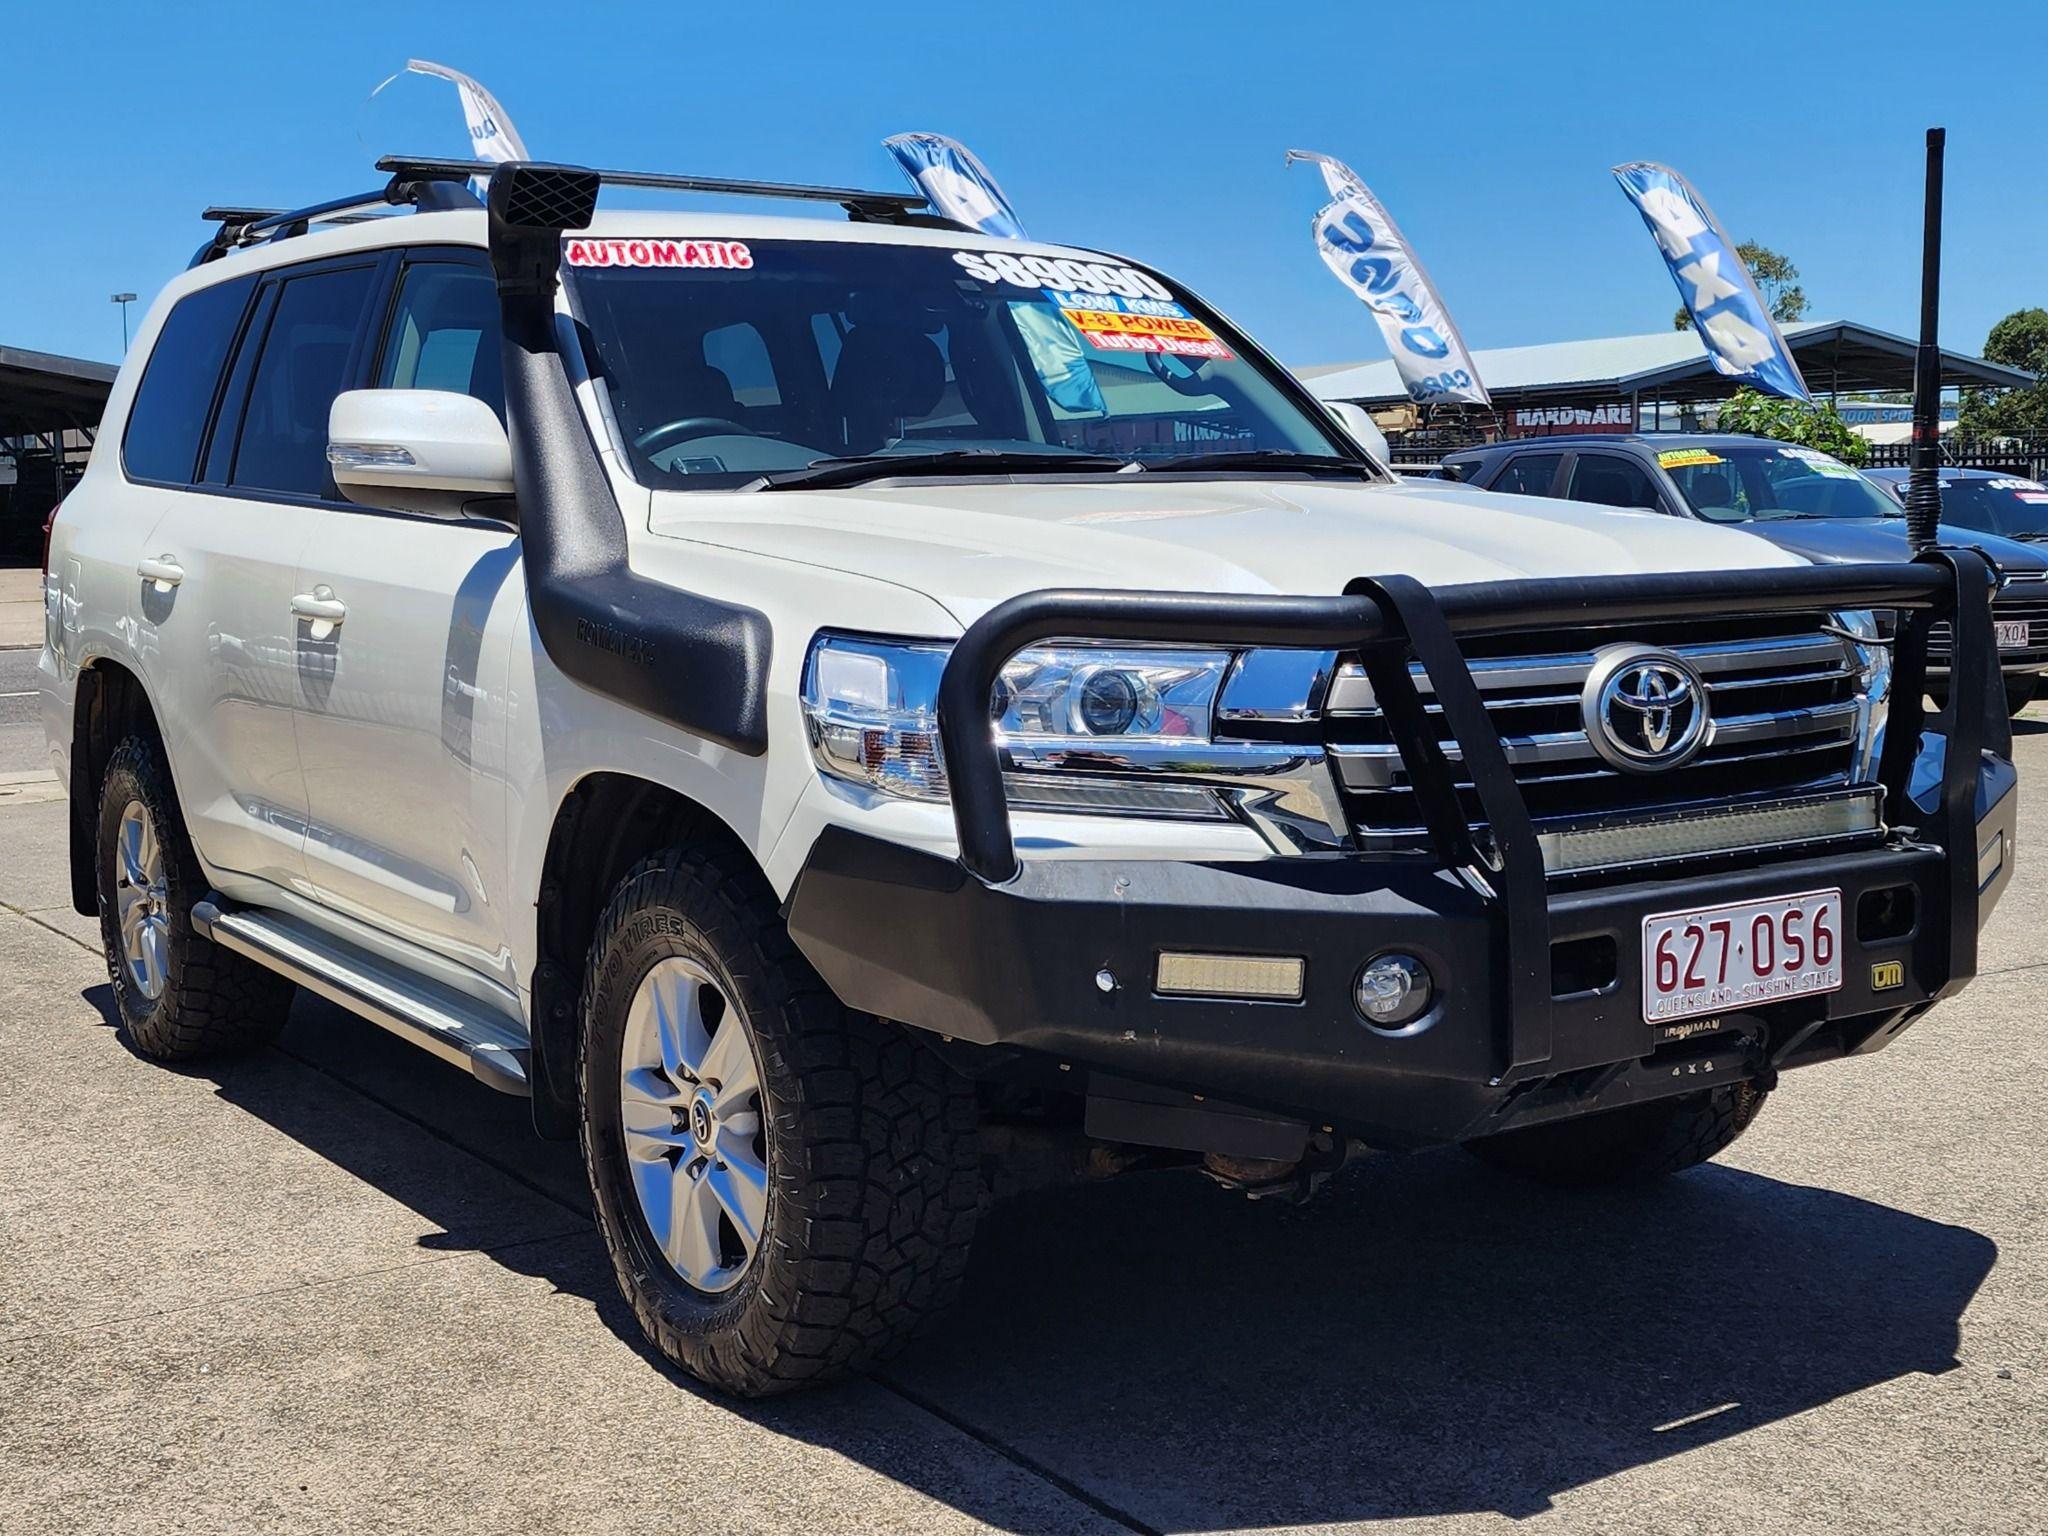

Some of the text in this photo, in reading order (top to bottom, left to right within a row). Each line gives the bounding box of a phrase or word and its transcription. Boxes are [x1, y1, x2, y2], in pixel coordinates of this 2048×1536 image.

[567, 240, 753, 268] AUTOMATIC
[952, 251, 1174, 301] $89990
[1053, 290, 1185, 317] LOW KMS
[1068, 311, 1208, 335] V-8 POWER
[1093, 331, 1226, 356] Turbo Diesel
[1516, 403, 1632, 426] HARDWARE
[620, 913, 686, 954] TIRES
[1656, 987, 1732, 1016] QUEENSLAND
[1743, 976, 1798, 998] SUNSHINE
[1801, 969, 1834, 988] STATE
[1664, 1019, 1720, 1039] IRONMAN
